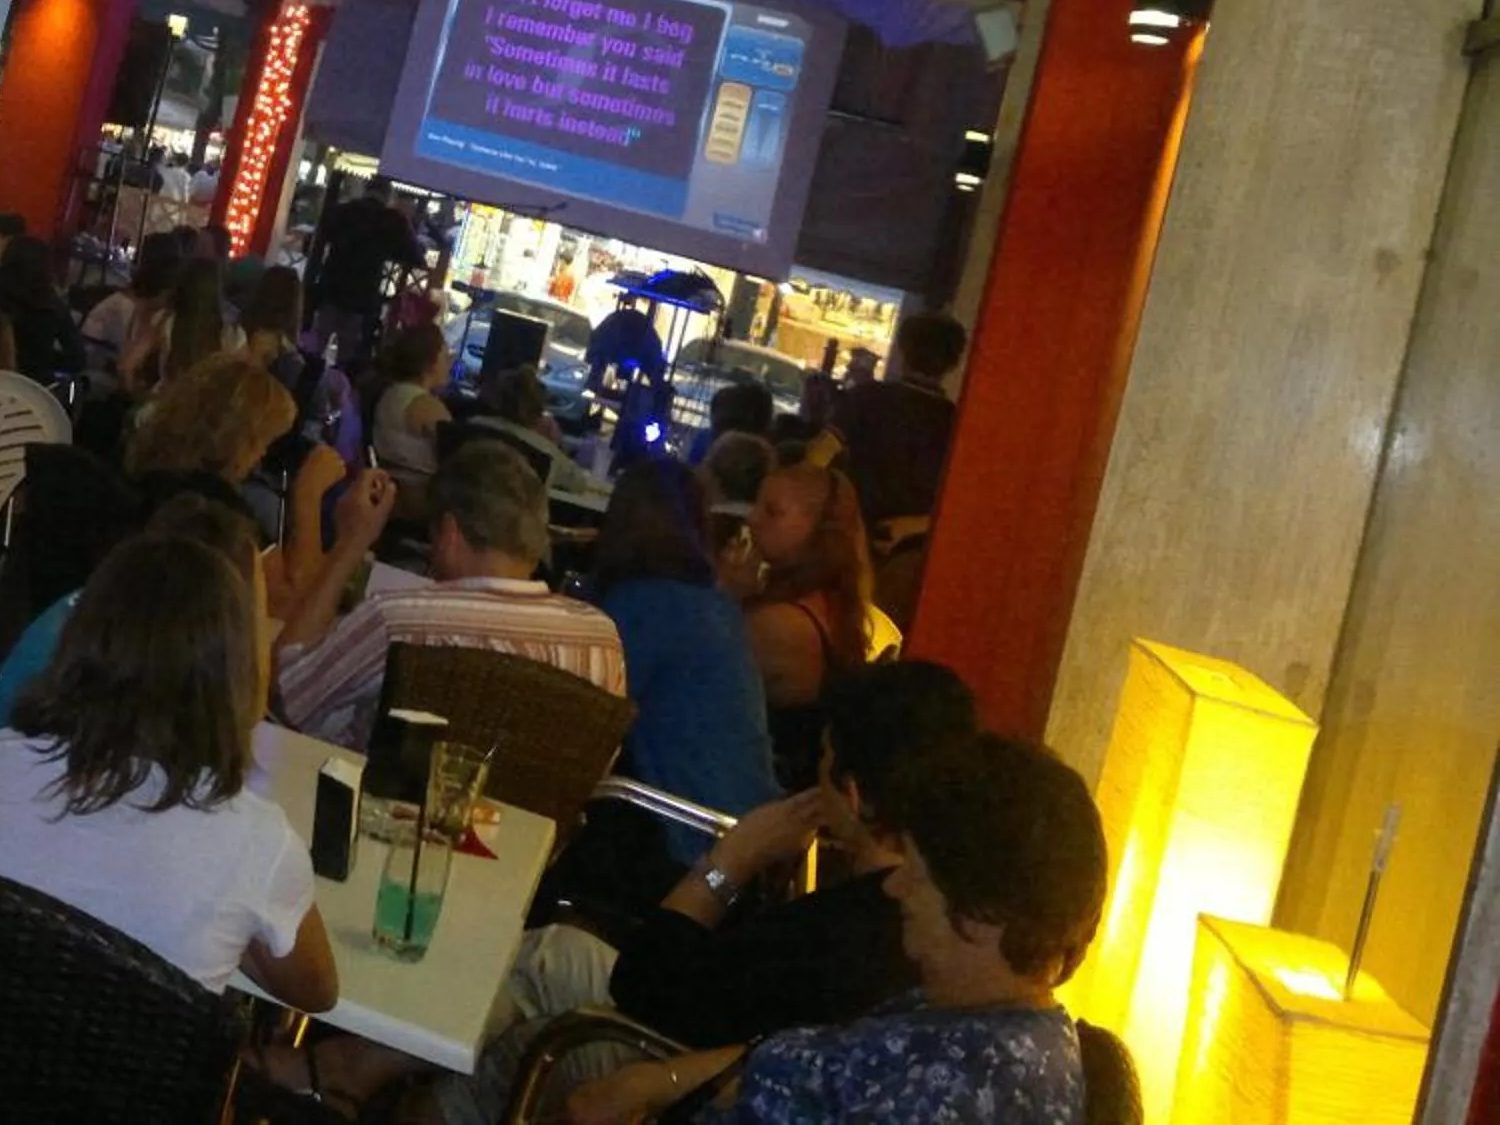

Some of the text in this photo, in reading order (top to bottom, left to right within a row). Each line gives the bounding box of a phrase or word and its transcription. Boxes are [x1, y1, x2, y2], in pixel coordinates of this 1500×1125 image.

[485, 7, 685, 68] I remember you said
[607, 8, 636, 27] me
[643, 13, 651, 29] I
[657, 14, 693, 44] beg
[487, 65, 526, 90] love
[531, 76, 565, 100] but
[569, 88, 676, 125] sometimes
[602, 61, 617, 82] it
[621, 68, 670, 94] lasts
[503, 98, 553, 127] hurts
